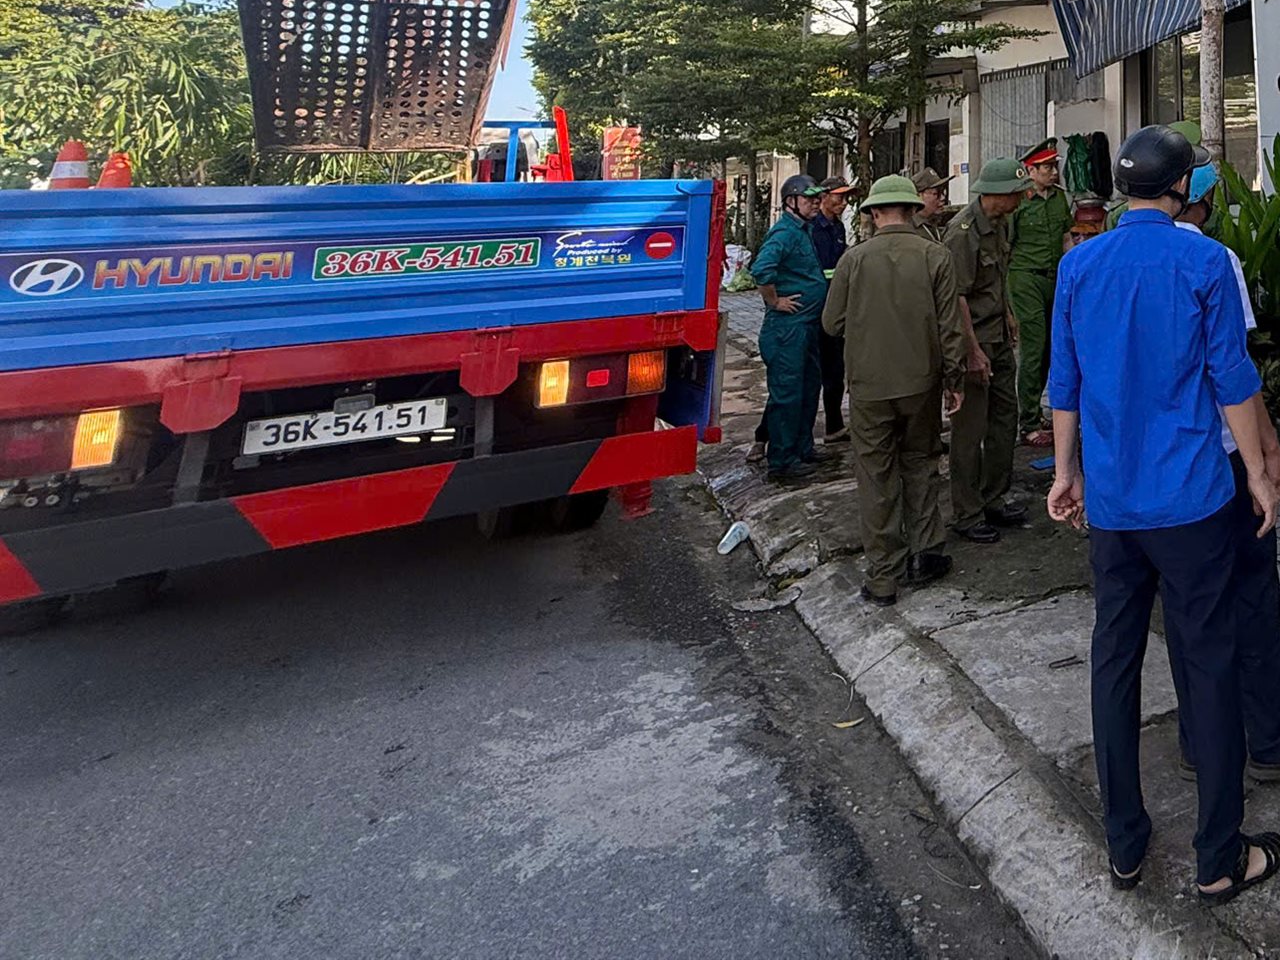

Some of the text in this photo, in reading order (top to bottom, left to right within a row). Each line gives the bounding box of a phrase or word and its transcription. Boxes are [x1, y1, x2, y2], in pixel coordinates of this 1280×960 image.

[92, 251, 295, 290] HYUNDAI
[321, 242, 535, 276] 36K-541.51
[262, 404, 428, 447] 36K-541.51
